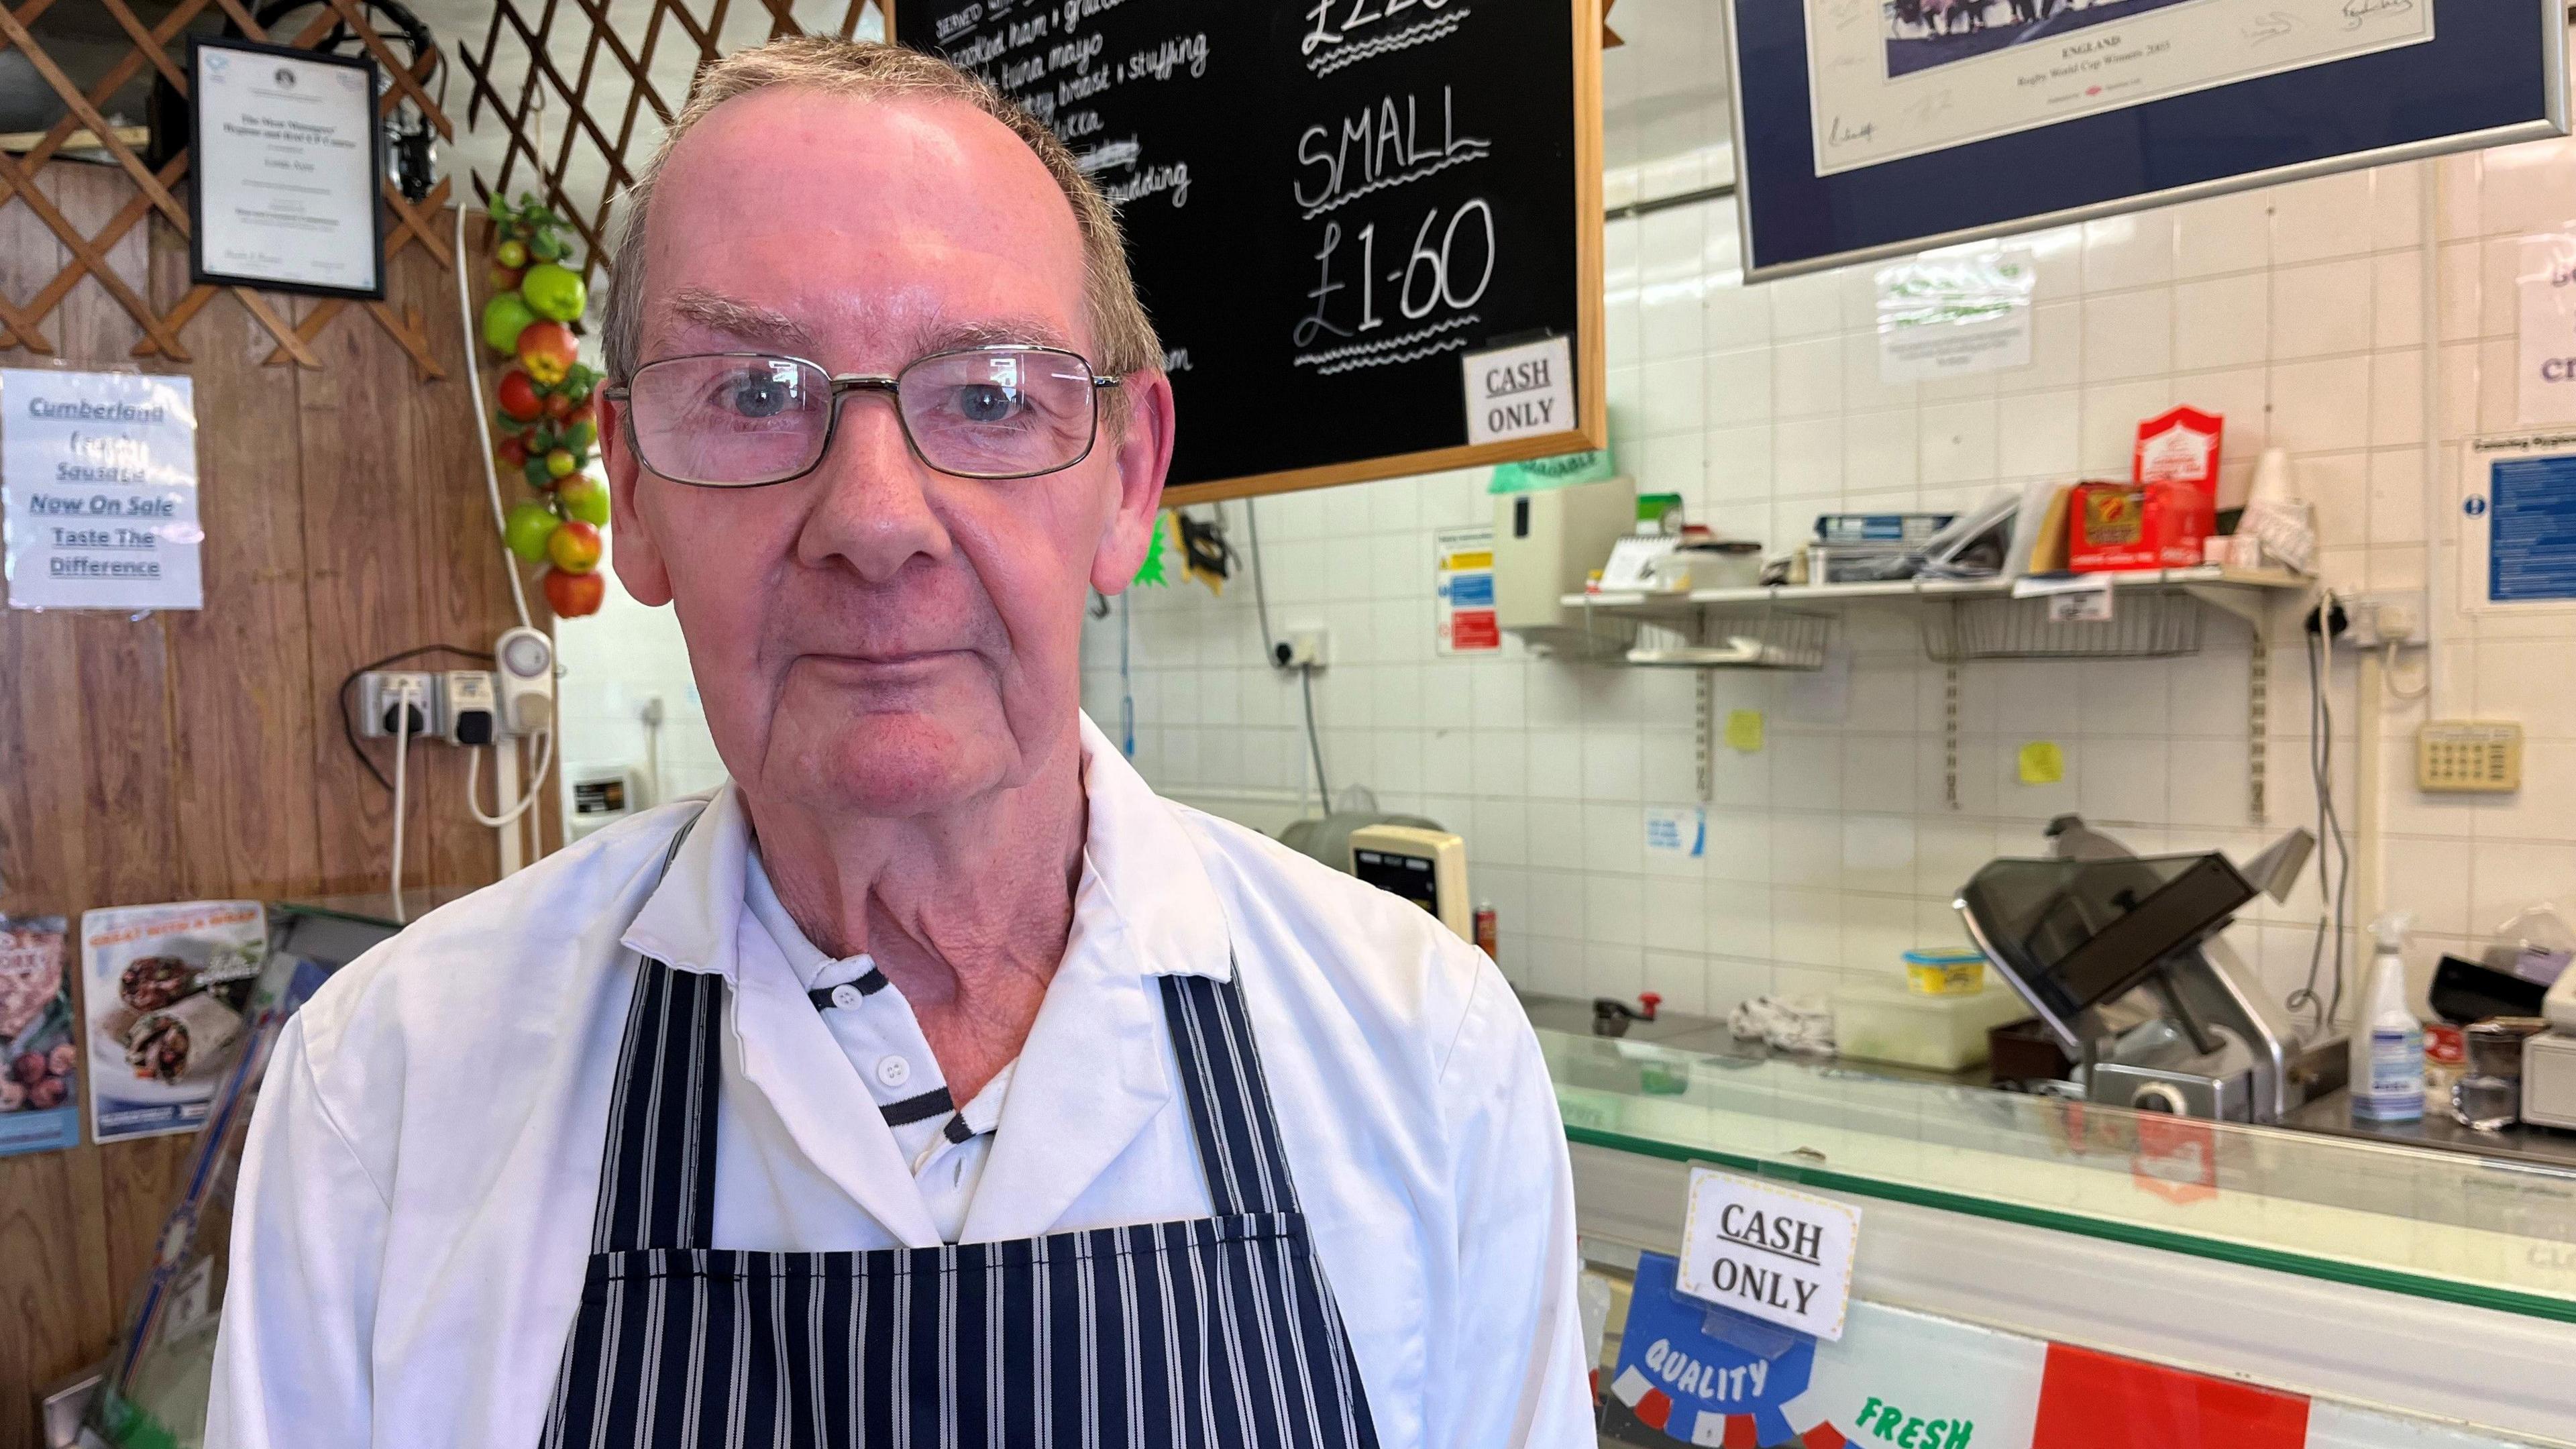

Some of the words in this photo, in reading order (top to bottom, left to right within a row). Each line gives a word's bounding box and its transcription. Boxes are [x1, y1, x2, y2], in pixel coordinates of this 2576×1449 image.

[1008, 15, 1048, 49] ham
[2061, 36, 2122, 59] ENGLAND
[1048, 31, 1104, 75] mayo
[1058, 63, 1111, 107] breast
[1127, 32, 1210, 80] stuffing
[2017, 74, 2047, 86] Rugby
[2049, 64, 2080, 78] World
[2080, 59, 2102, 71] Cup
[2104, 50, 2143, 65] Winners
[1293, 85, 1491, 207] SMALL
[1485, 358, 1552, 397] CASH
[29, 396, 164, 422] Cumberland
[1488, 397, 1554, 433] ONLY
[30, 494, 83, 516] Now
[90, 494, 121, 517] On
[128, 496, 175, 518] Sale
[50, 527, 110, 548] Taste
[115, 528, 155, 548] The
[50, 556, 162, 579] Difference
[1717, 1203, 1824, 1266] CASH
[1711, 1256, 1820, 1315] ONLY
[1645, 1338, 1770, 1402] QUALITY
[1856, 1396, 1974, 1449] FRESH
